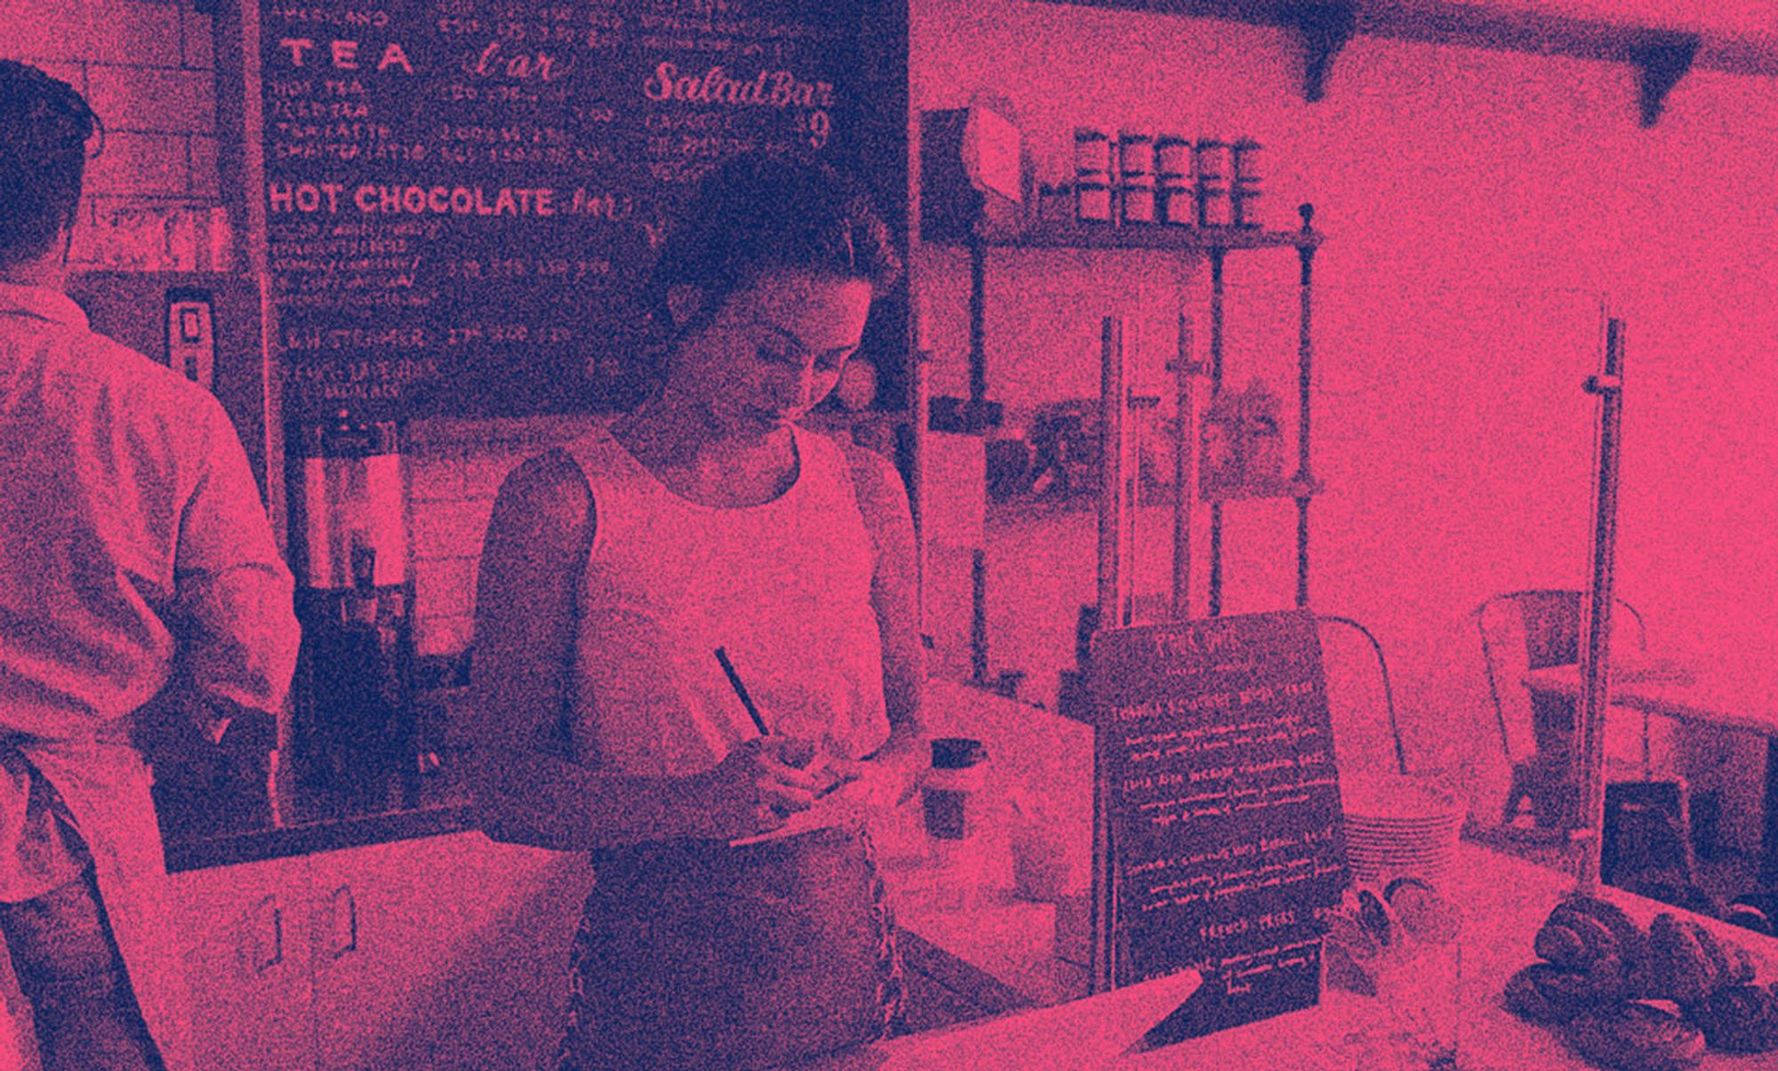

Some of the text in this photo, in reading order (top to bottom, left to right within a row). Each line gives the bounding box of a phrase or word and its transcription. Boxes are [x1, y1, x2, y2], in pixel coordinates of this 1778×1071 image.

[278, 37, 415, 75] TEA
[324, 79, 366, 98] TEA
[644, 61, 835, 107] Salad Bar
[330, 102, 369, 119] TEA
[268, 182, 344, 214] HOT
[353, 184, 555, 217] CHOCOLATE
